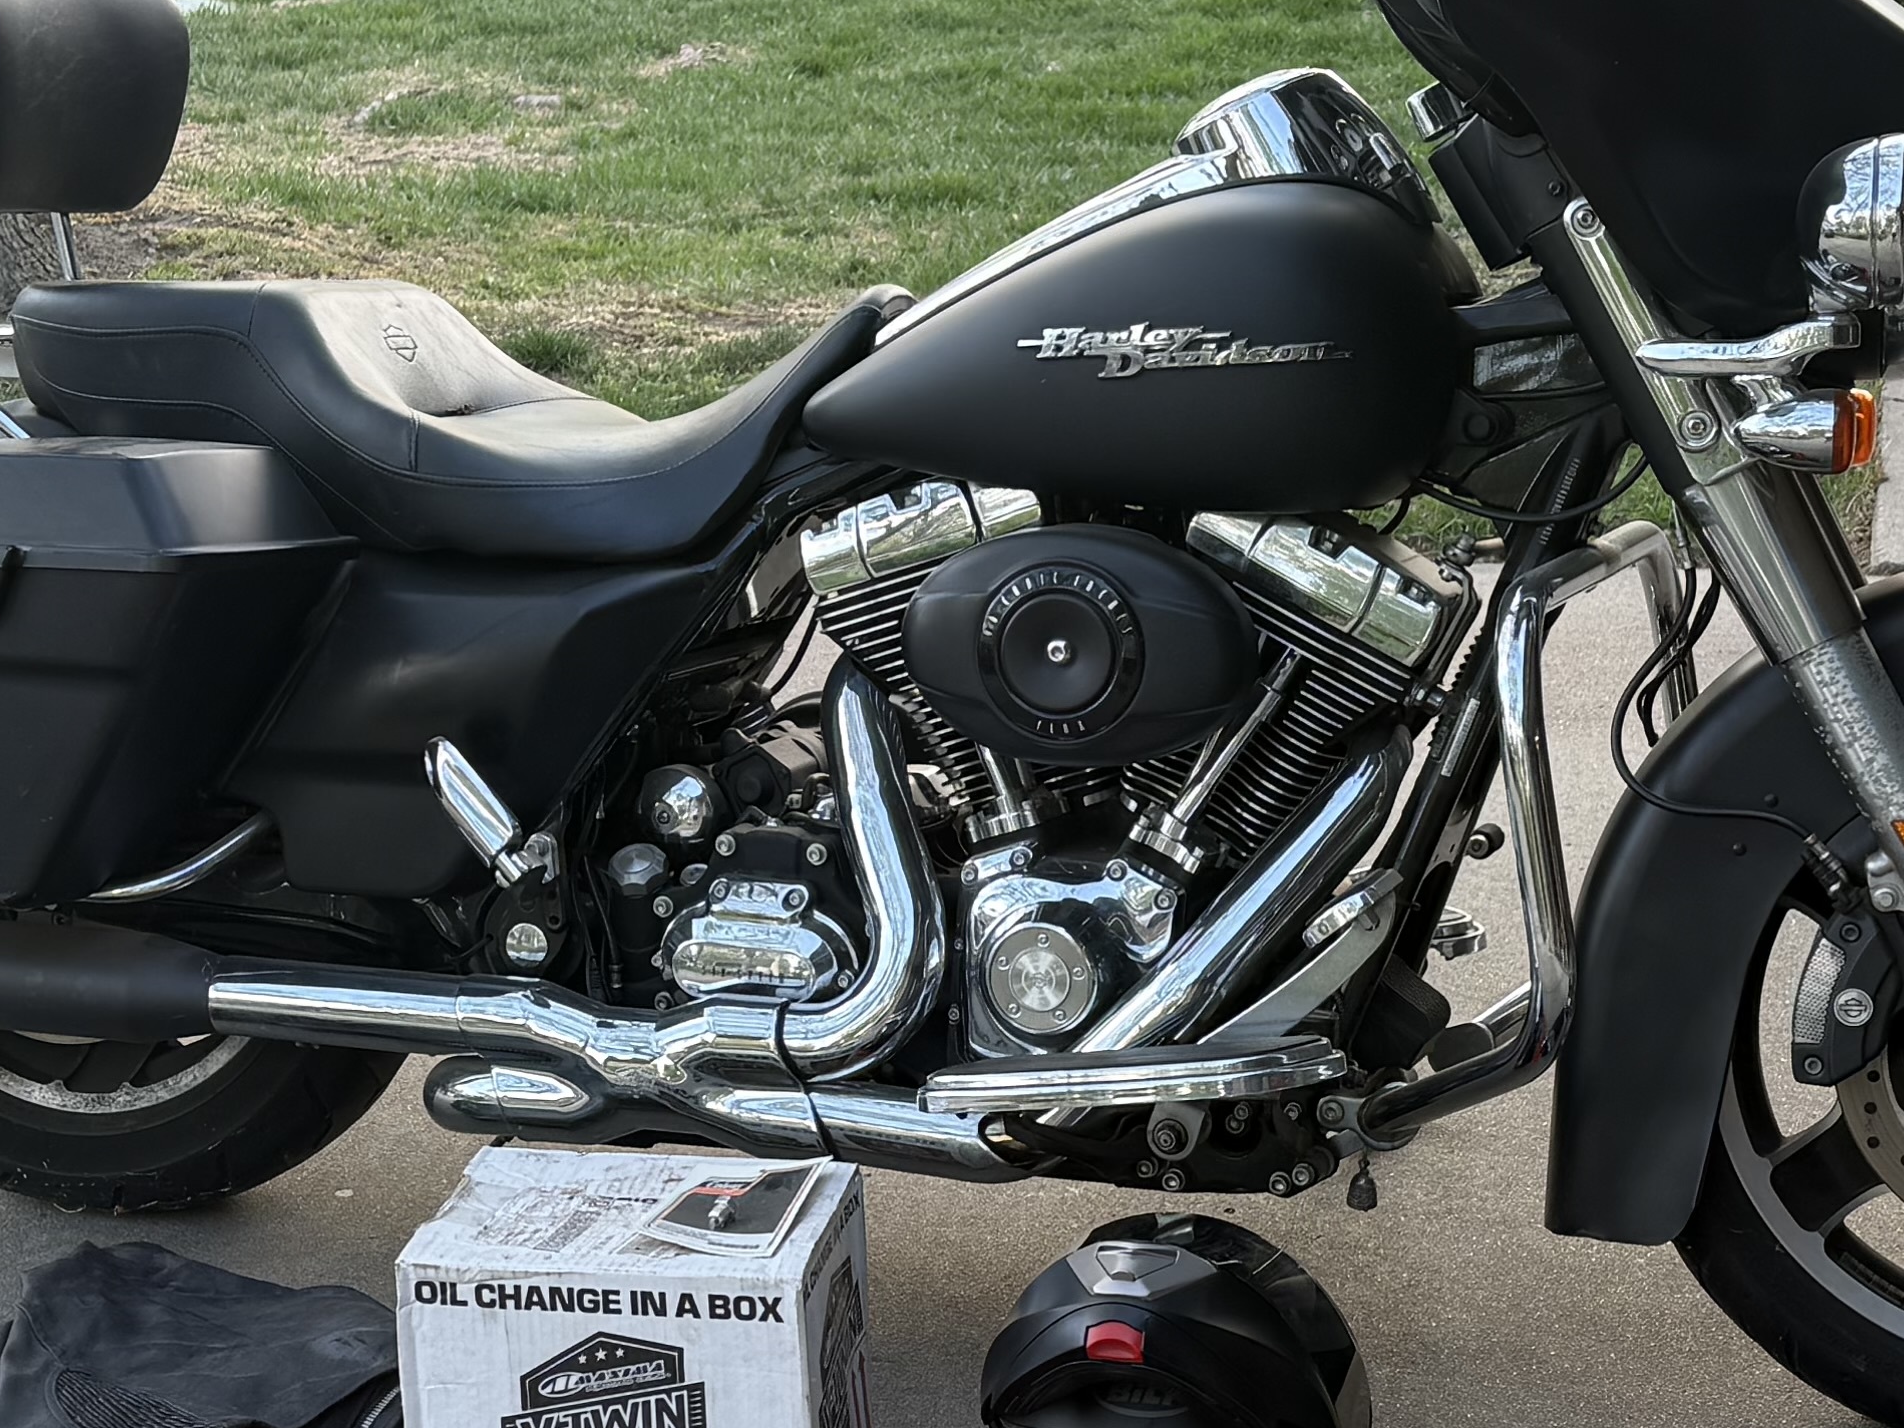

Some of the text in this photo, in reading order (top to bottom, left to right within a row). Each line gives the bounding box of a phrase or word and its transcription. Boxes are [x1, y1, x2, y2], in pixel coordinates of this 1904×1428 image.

[1034, 321, 1204, 359] Harley
[1097, 337, 1335, 379] Davidson
[844, 1189, 861, 1225] BOX
[413, 1279, 785, 1324] OIL CHANGE IN A BOX
